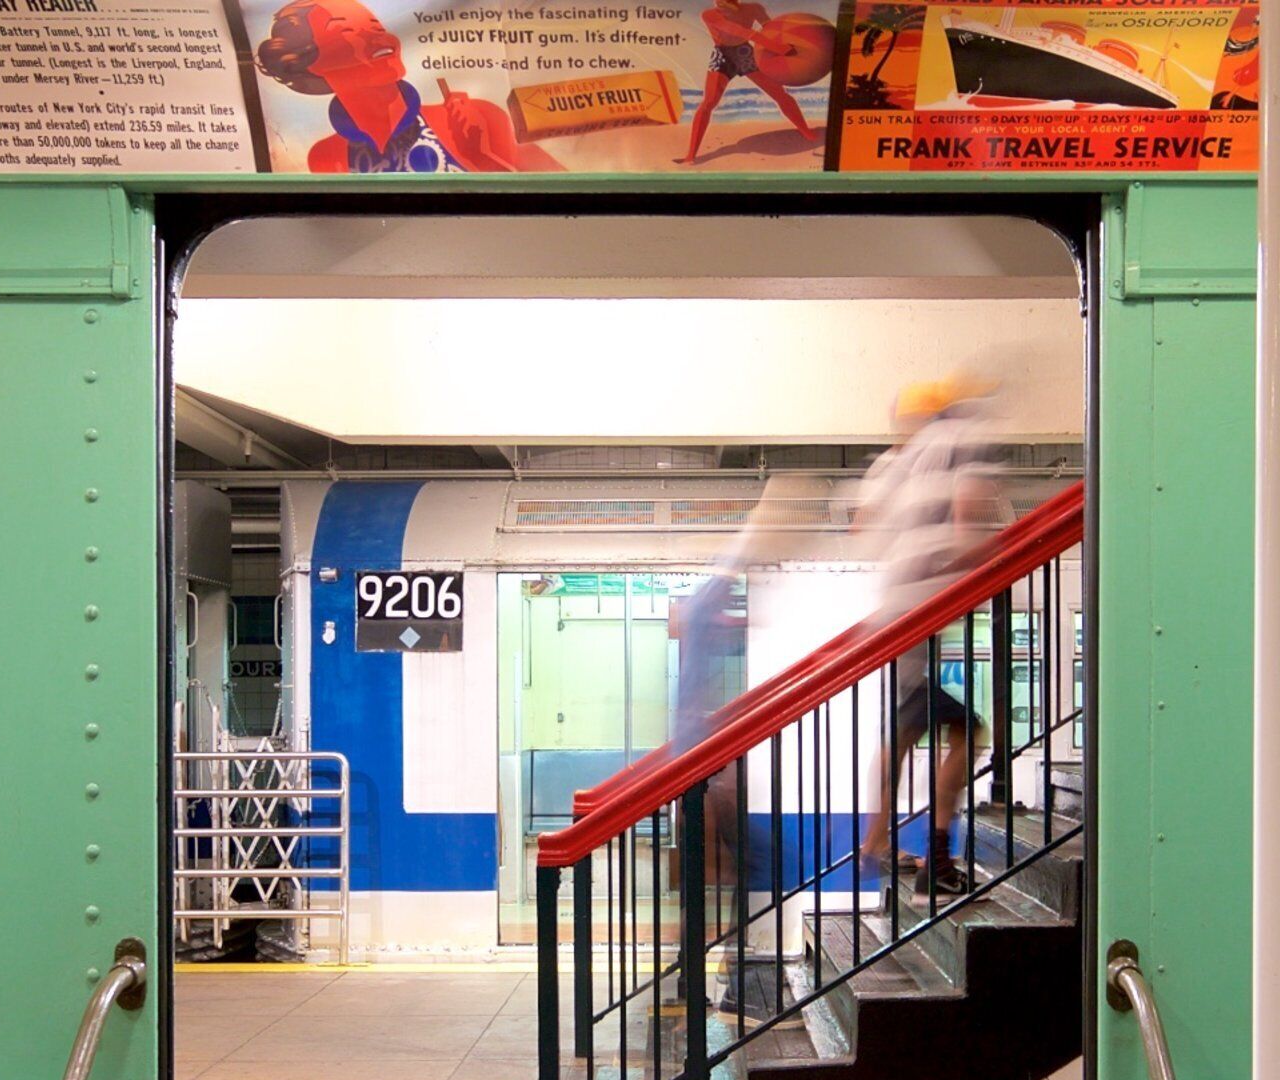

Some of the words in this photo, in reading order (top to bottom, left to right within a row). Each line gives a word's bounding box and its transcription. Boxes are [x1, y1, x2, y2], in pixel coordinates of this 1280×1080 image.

[414, 10, 454, 23] You'll
[459, 8, 502, 22] enjoy
[508, 8, 534, 20] the
[539, 7, 629, 22] fascinating
[636, 6, 683, 20] flavor
[1122, 17, 1229, 28] OSLOFJORD
[44, 26, 84, 38] Tunnel,
[178, 27, 219, 39] longest
[438, 30, 484, 43] JUICY
[489, 30, 534, 44] FRUIT
[538, 33, 579, 48] gum.
[585, 30, 606, 43] It's
[609, 30, 687, 46] different-
[15, 41, 48, 52] tunnel
[108, 42, 144, 53] world's
[146, 42, 182, 53] second
[185, 43, 223, 55] longest
[49, 57, 94, 70] (Longest
[184, 58, 227, 71] England,
[537, 56, 563, 70] fun
[568, 57, 584, 69] to
[588, 55, 635, 69] chew.
[1, 73, 30, 84] under
[33, 73, 70, 86] Mersey
[543, 80, 606, 96] WRIGLEY'S
[547, 94, 594, 112] JUICY
[596, 89, 643, 106] FRUIT
[0, 102, 33, 113] routes
[53, 102, 74, 113] New
[77, 102, 102, 114] York
[106, 102, 135, 116] City's
[139, 102, 166, 117] rapid
[170, 103, 206, 115] transit
[209, 103, 235, 116] lines
[45, 119, 91, 132] elevated)
[94, 120, 126, 132] extend
[129, 120, 163, 133] 236.59
[166, 120, 194, 133] miles.
[210, 121, 238, 134] takes
[858, 115, 882, 125] SUN
[888, 115, 923, 125] TRAIL
[929, 115, 981, 125] CRUISES
[1000, 115, 1030, 125] DAYS
[1101, 115, 1131, 124] DAYS
[970, 126, 1007, 135] APPLY
[1014, 126, 1045, 135] YOUR
[1051, 125, 1086, 134] LOCAL
[1091, 125, 1127, 134] AGENT
[12, 136, 35, 147] than
[37, 136, 92, 149] 50,000,000
[95, 137, 127, 149] tokens
[143, 138, 167, 151] keep
[205, 139, 240, 152] change
[876, 138, 974, 159] FRANK
[985, 137, 1096, 159] TRAVEL
[1113, 137, 1233, 159] SERVICE
[25, 153, 77, 167] adequately
[81, 154, 122, 167] supplied.
[359, 576, 461, 618] 9206
